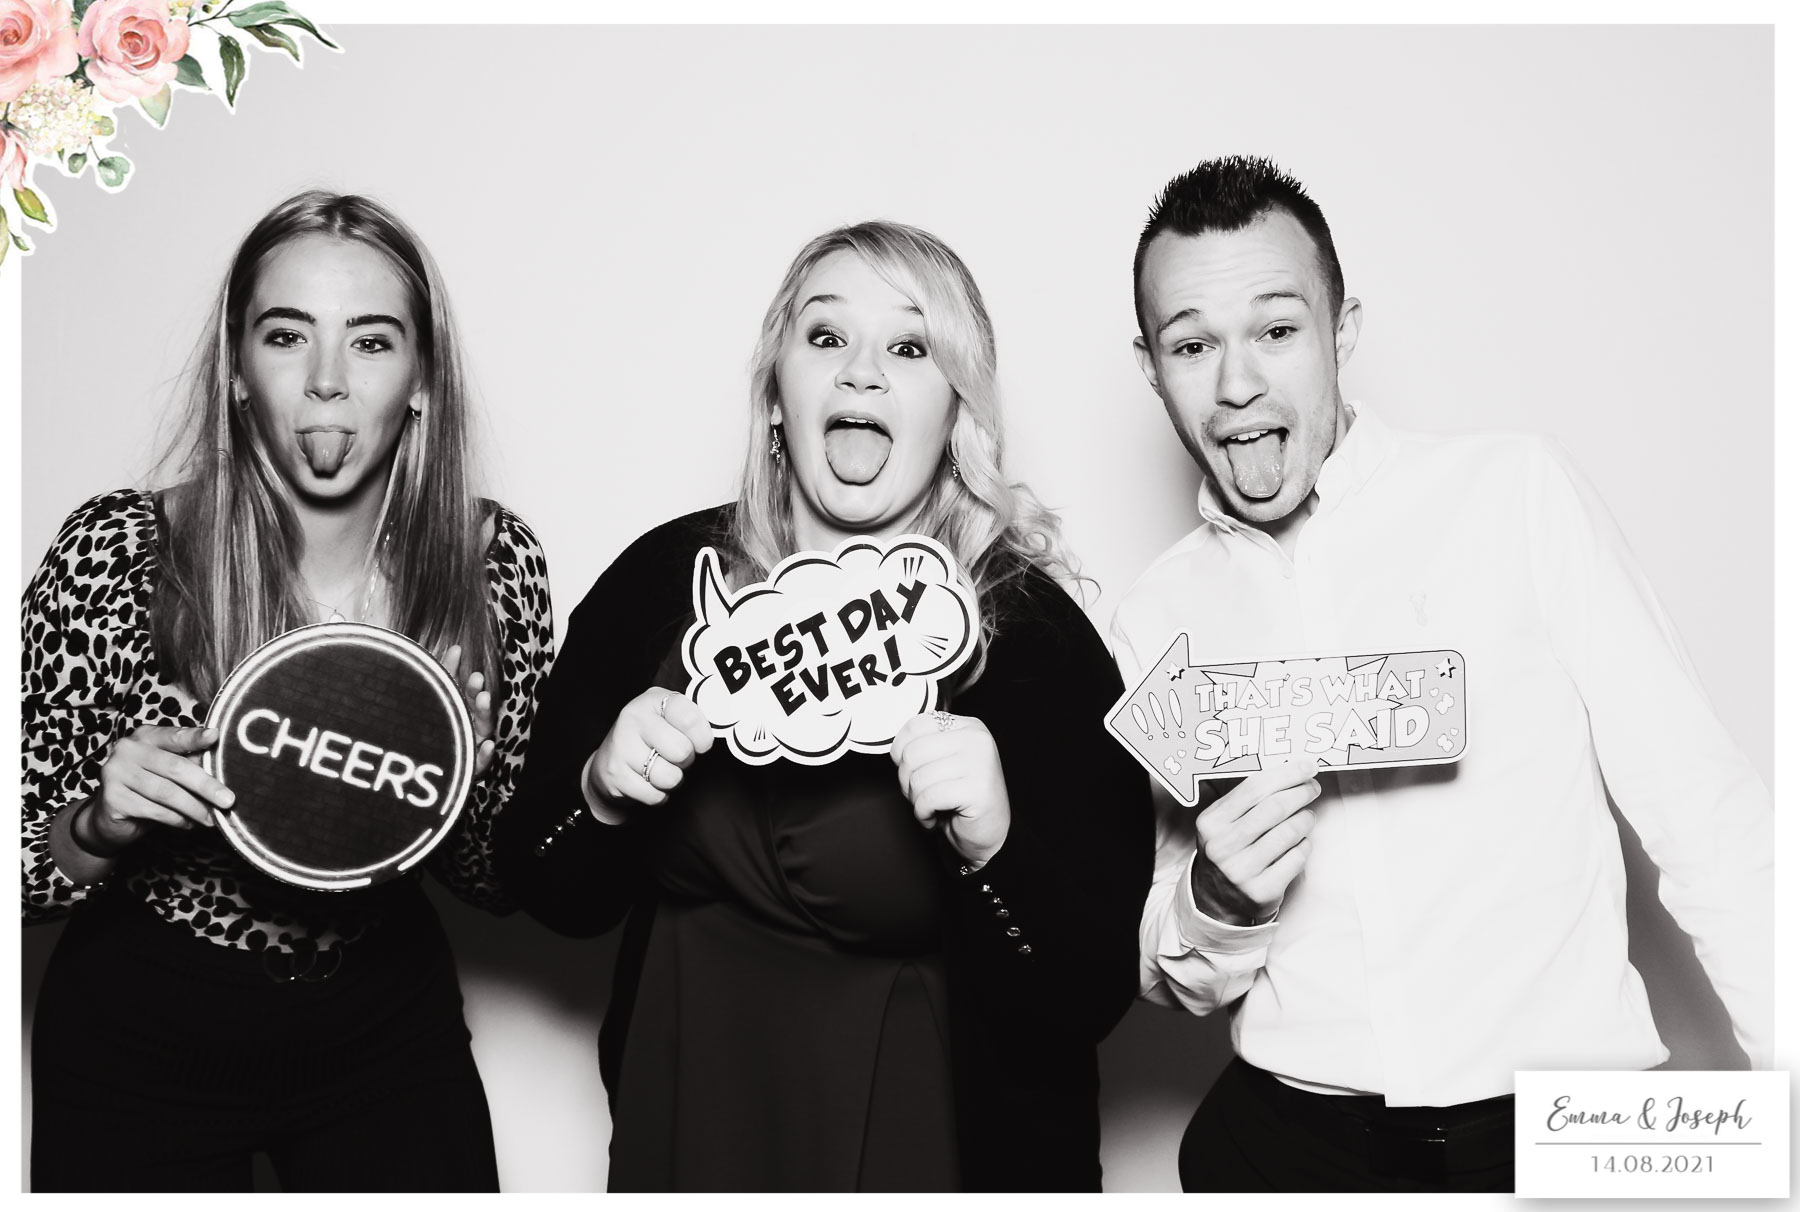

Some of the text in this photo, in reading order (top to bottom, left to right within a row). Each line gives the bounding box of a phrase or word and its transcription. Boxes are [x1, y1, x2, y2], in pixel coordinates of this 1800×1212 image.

[713, 579, 927, 695] BEST DAY
[770, 634, 907, 717] EVER!
[1195, 669, 1426, 713] THAT'S WHAT
[237, 708, 444, 808] CHEERS
[1194, 705, 1430, 761] SHE SAID
